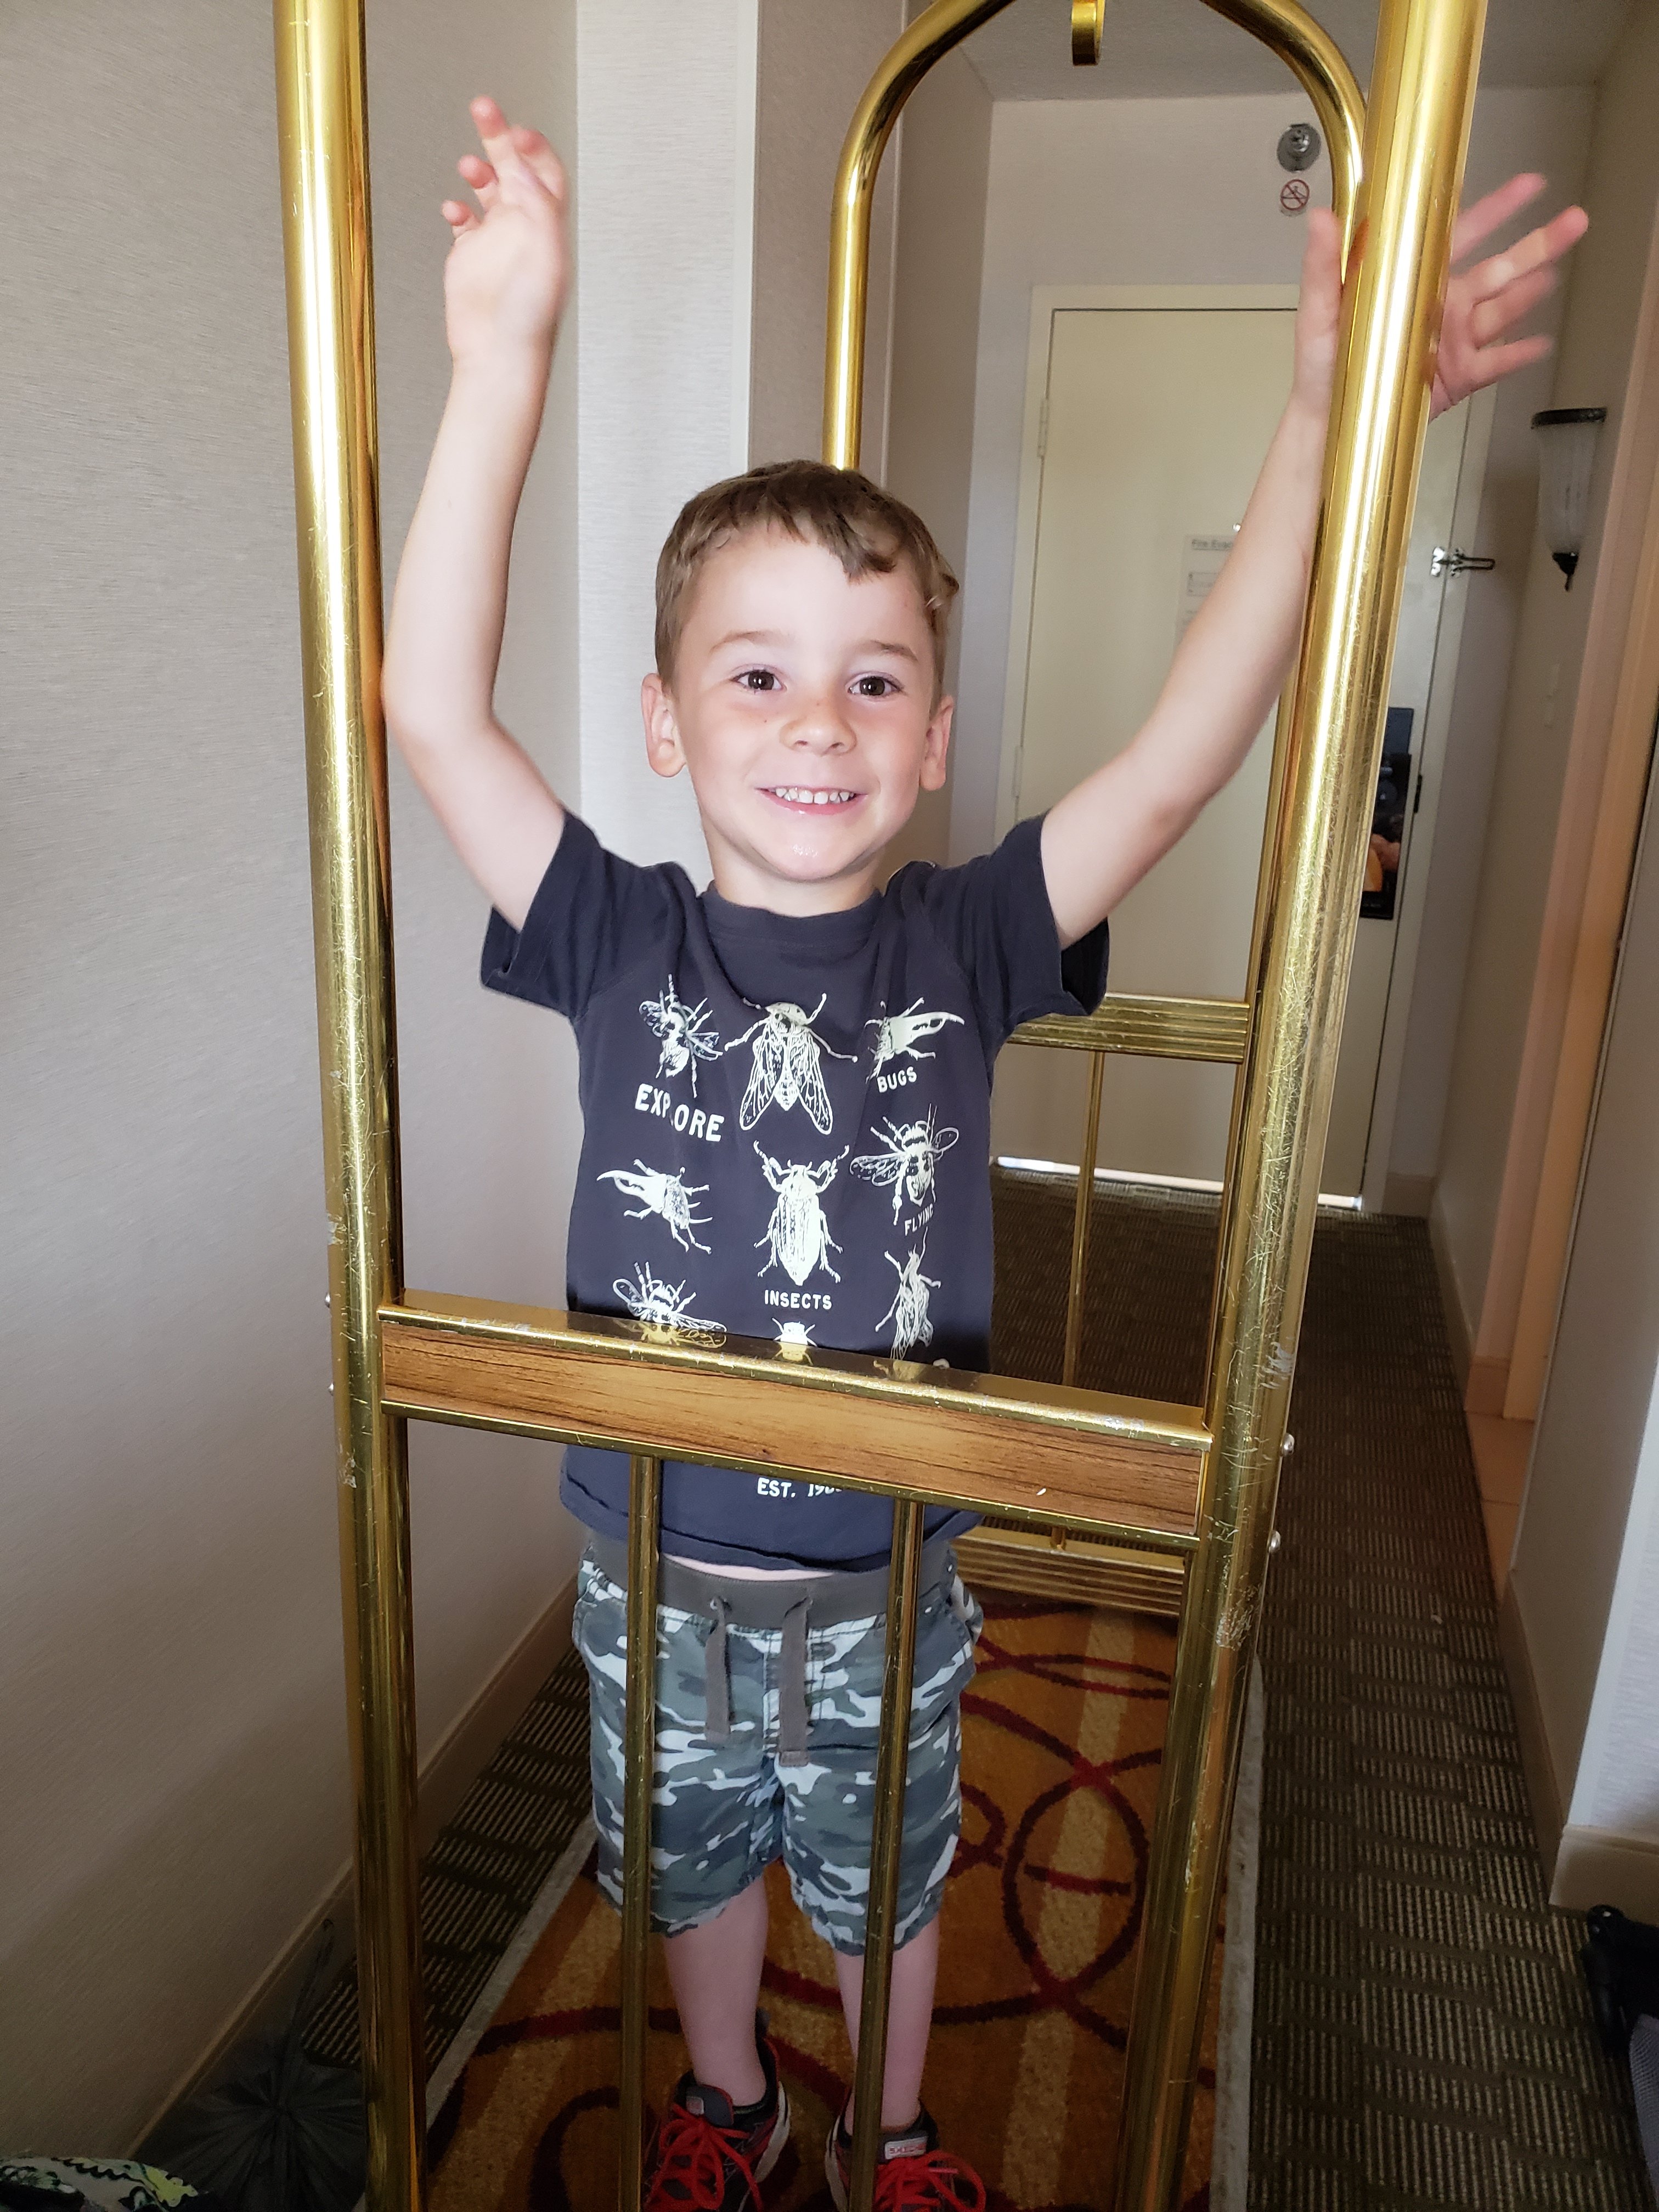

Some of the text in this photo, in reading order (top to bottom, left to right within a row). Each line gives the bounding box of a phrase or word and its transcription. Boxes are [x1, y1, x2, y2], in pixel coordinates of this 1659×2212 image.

[877, 1066, 917, 1093] BUGS
[635, 1083, 725, 1142] EXPORE
[905, 1203, 933, 1237] FLYING
[764, 1289, 832, 1310] INSECTS
[757, 1477, 843, 1498] EST. 19
